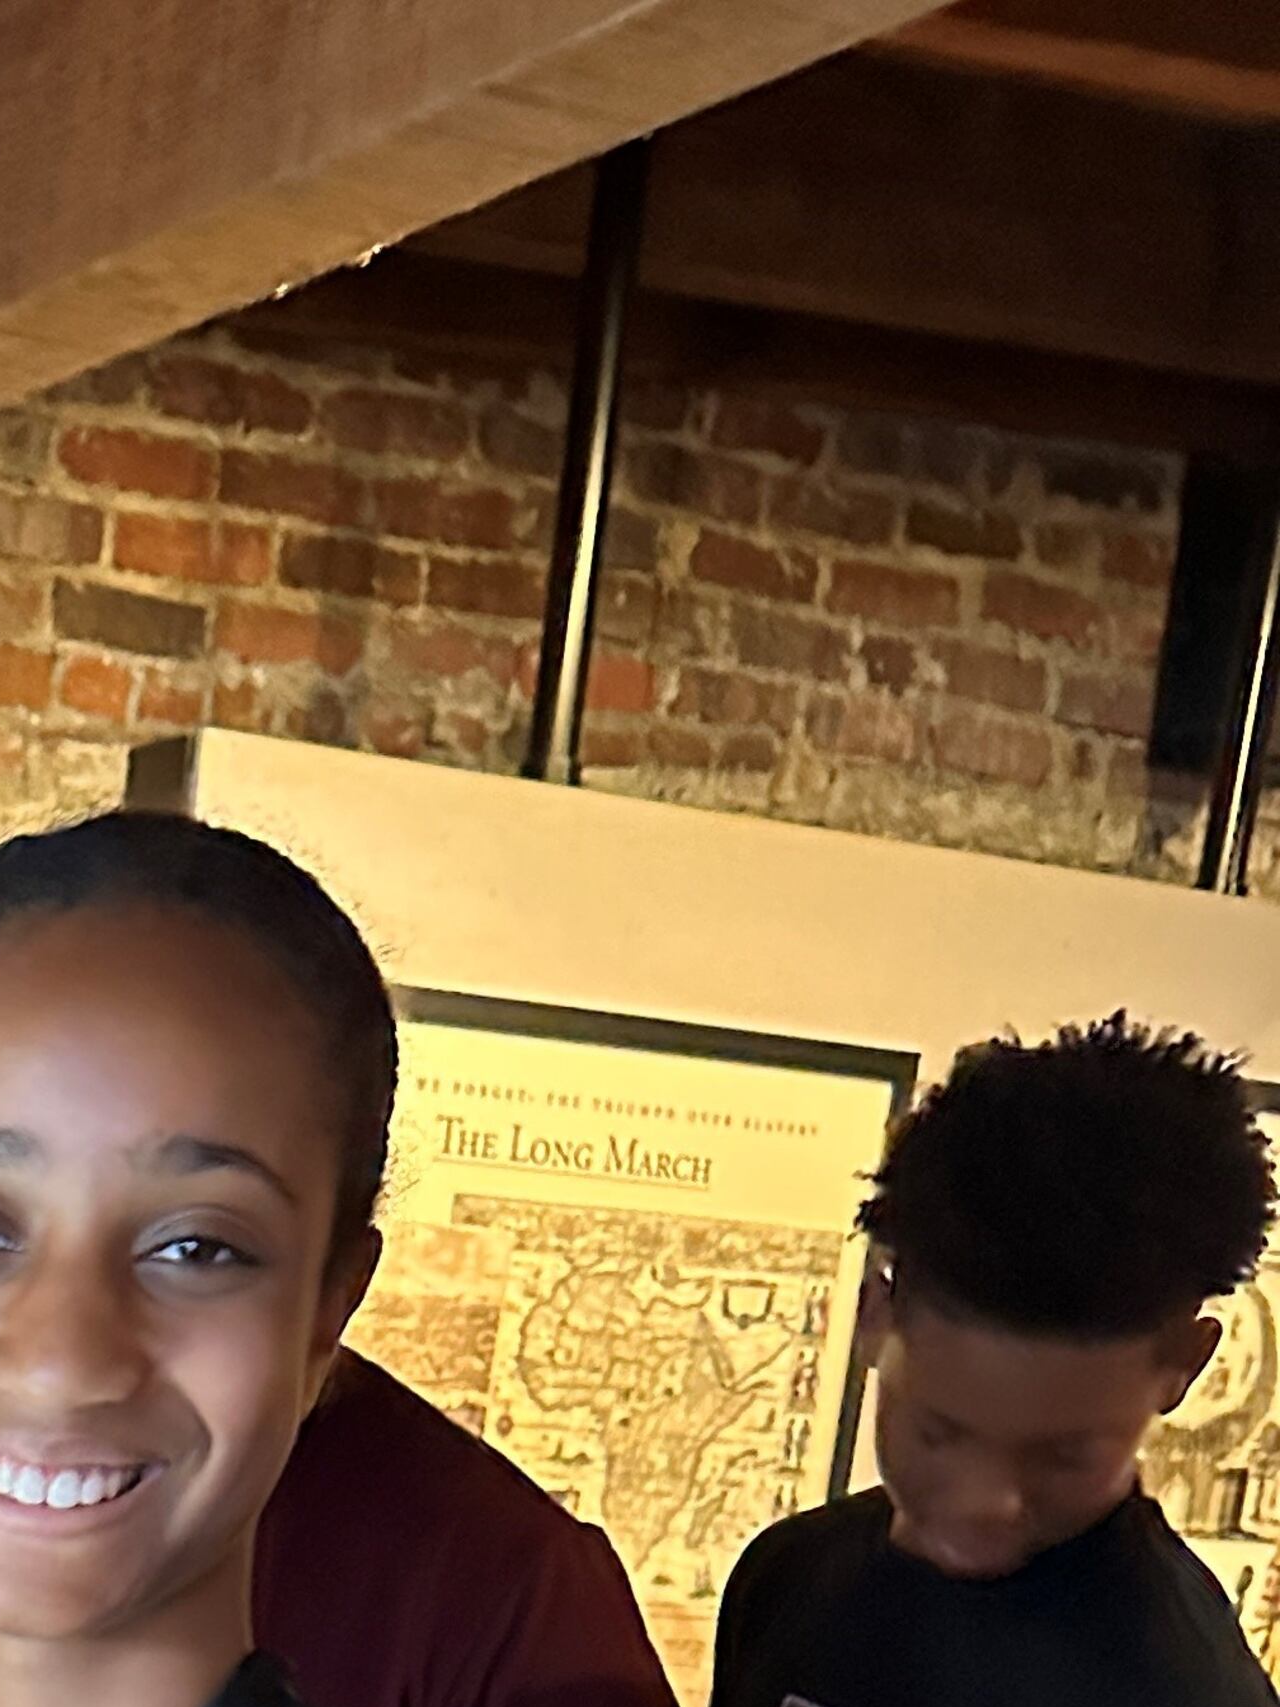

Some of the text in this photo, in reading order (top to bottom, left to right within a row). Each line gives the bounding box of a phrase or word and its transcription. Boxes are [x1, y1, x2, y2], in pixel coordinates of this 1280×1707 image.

[436, 1113, 712, 1184] THE LONG MARCH
